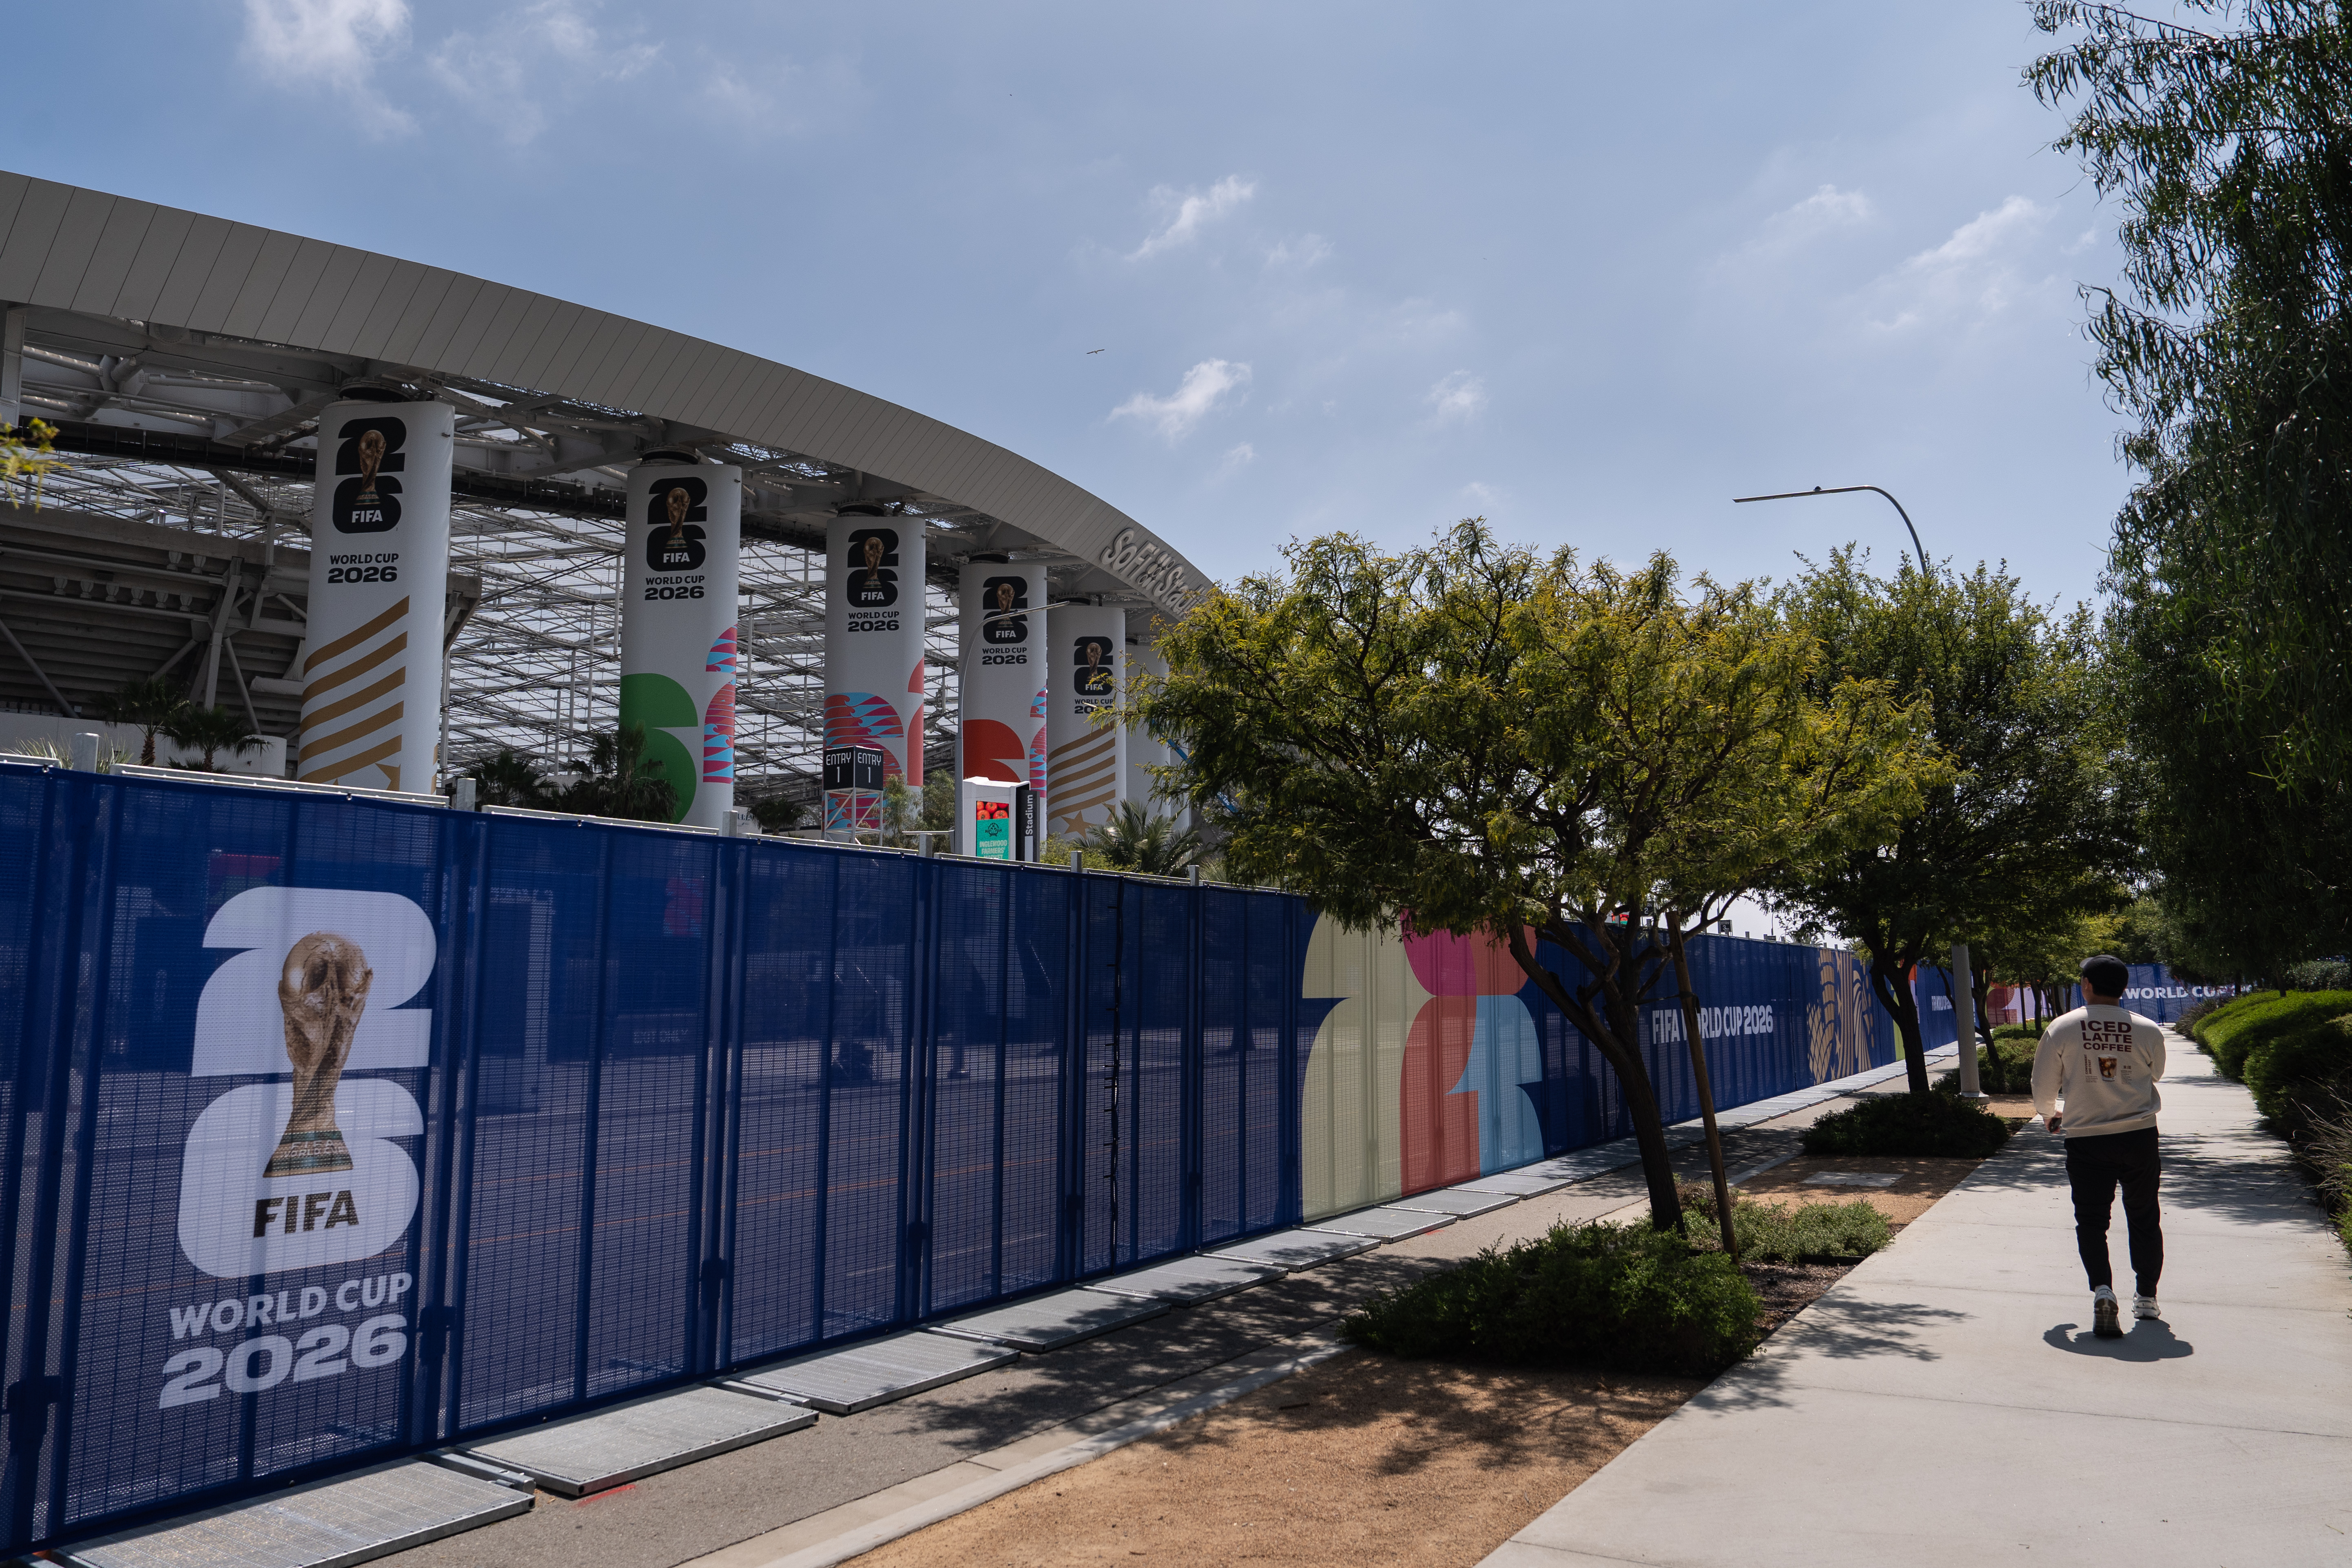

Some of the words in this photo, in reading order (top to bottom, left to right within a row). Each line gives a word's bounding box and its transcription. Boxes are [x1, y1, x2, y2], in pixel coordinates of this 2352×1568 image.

[352, 510, 383, 523] FIFA
[330, 554, 372, 565] WORLD
[374, 553, 399, 563] CUP
[663, 552, 690, 563] FIFA
[328, 566, 397, 584] 2026
[1100, 527, 1160, 579] SoFi
[1152, 564, 1207, 619] Stadi
[646, 576, 682, 585] WORLD
[684, 575, 705, 584] CUP
[644, 585, 704, 600] 2026
[861, 591, 884, 600] FIFA
[848, 620, 899, 632] 2026
[982, 654, 1027, 665] 2026
[826, 752, 851, 765] ENTRY
[858, 753, 881, 766] ENTRY
[837, 766, 840, 782] 1
[868, 767, 870, 783] 1
[2126, 986, 2189, 999] WORLD
[1652, 1009, 1680, 1044] FIFA
[1723, 1006, 1742, 1036] CUP
[1744, 1005, 1773, 1034] 2026
[2080, 1020, 2132, 1033] ICED
[2082, 1032, 2132, 1043] LATTE
[2083, 1042, 2132, 1052] COFFEE
[291, 1139, 334, 1149] FIFA
[281, 1148, 319, 1158] WORLD
[253, 1190, 359, 1238] FIFA
[169, 1285, 327, 1340] WORLD
[336, 1272, 412, 1313] CUP
[159, 1313, 408, 1409] 2026
